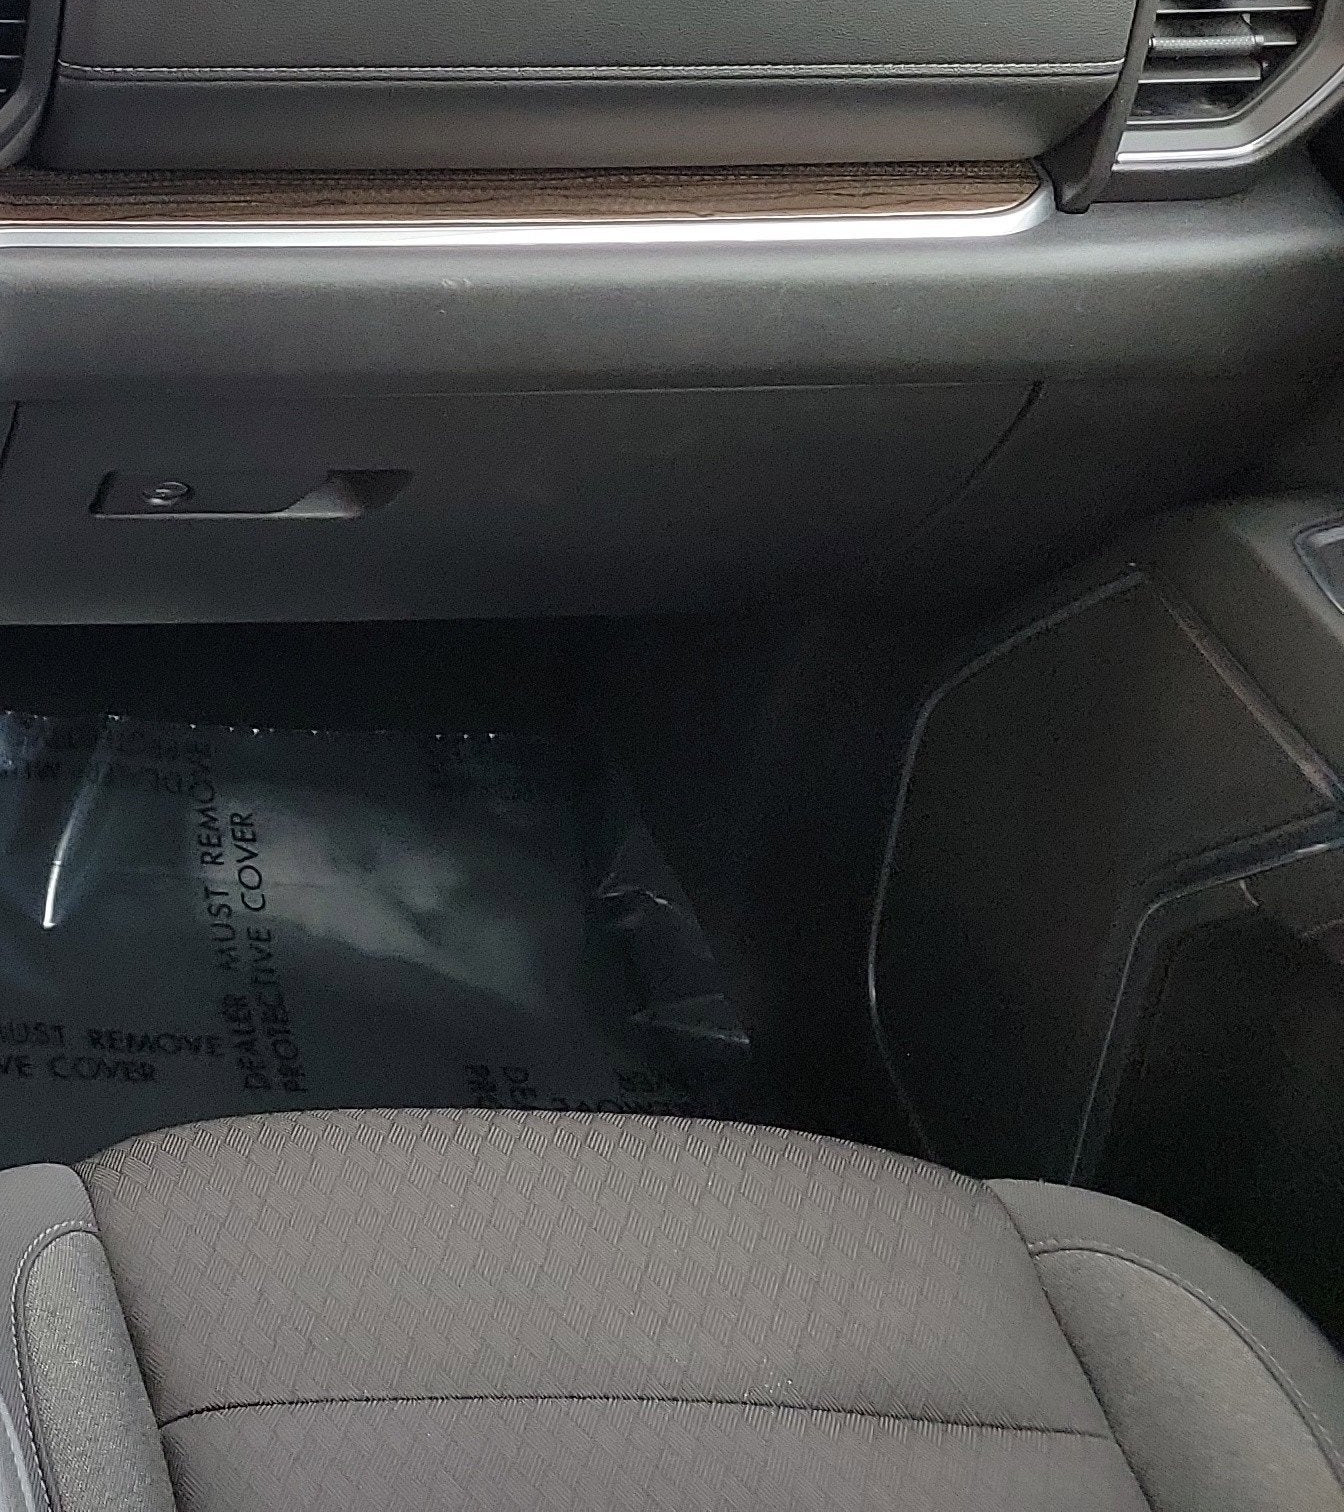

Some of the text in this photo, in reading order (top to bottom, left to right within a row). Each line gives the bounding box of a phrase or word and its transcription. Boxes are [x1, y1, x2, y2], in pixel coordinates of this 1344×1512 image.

[186, 742, 272, 1092] DEALER MUST REMOVE
[229, 810, 308, 1095] PROTECTIVE COVER
[46, 1054, 159, 1085] COVER
[85, 1026, 226, 1058] REMOVE
